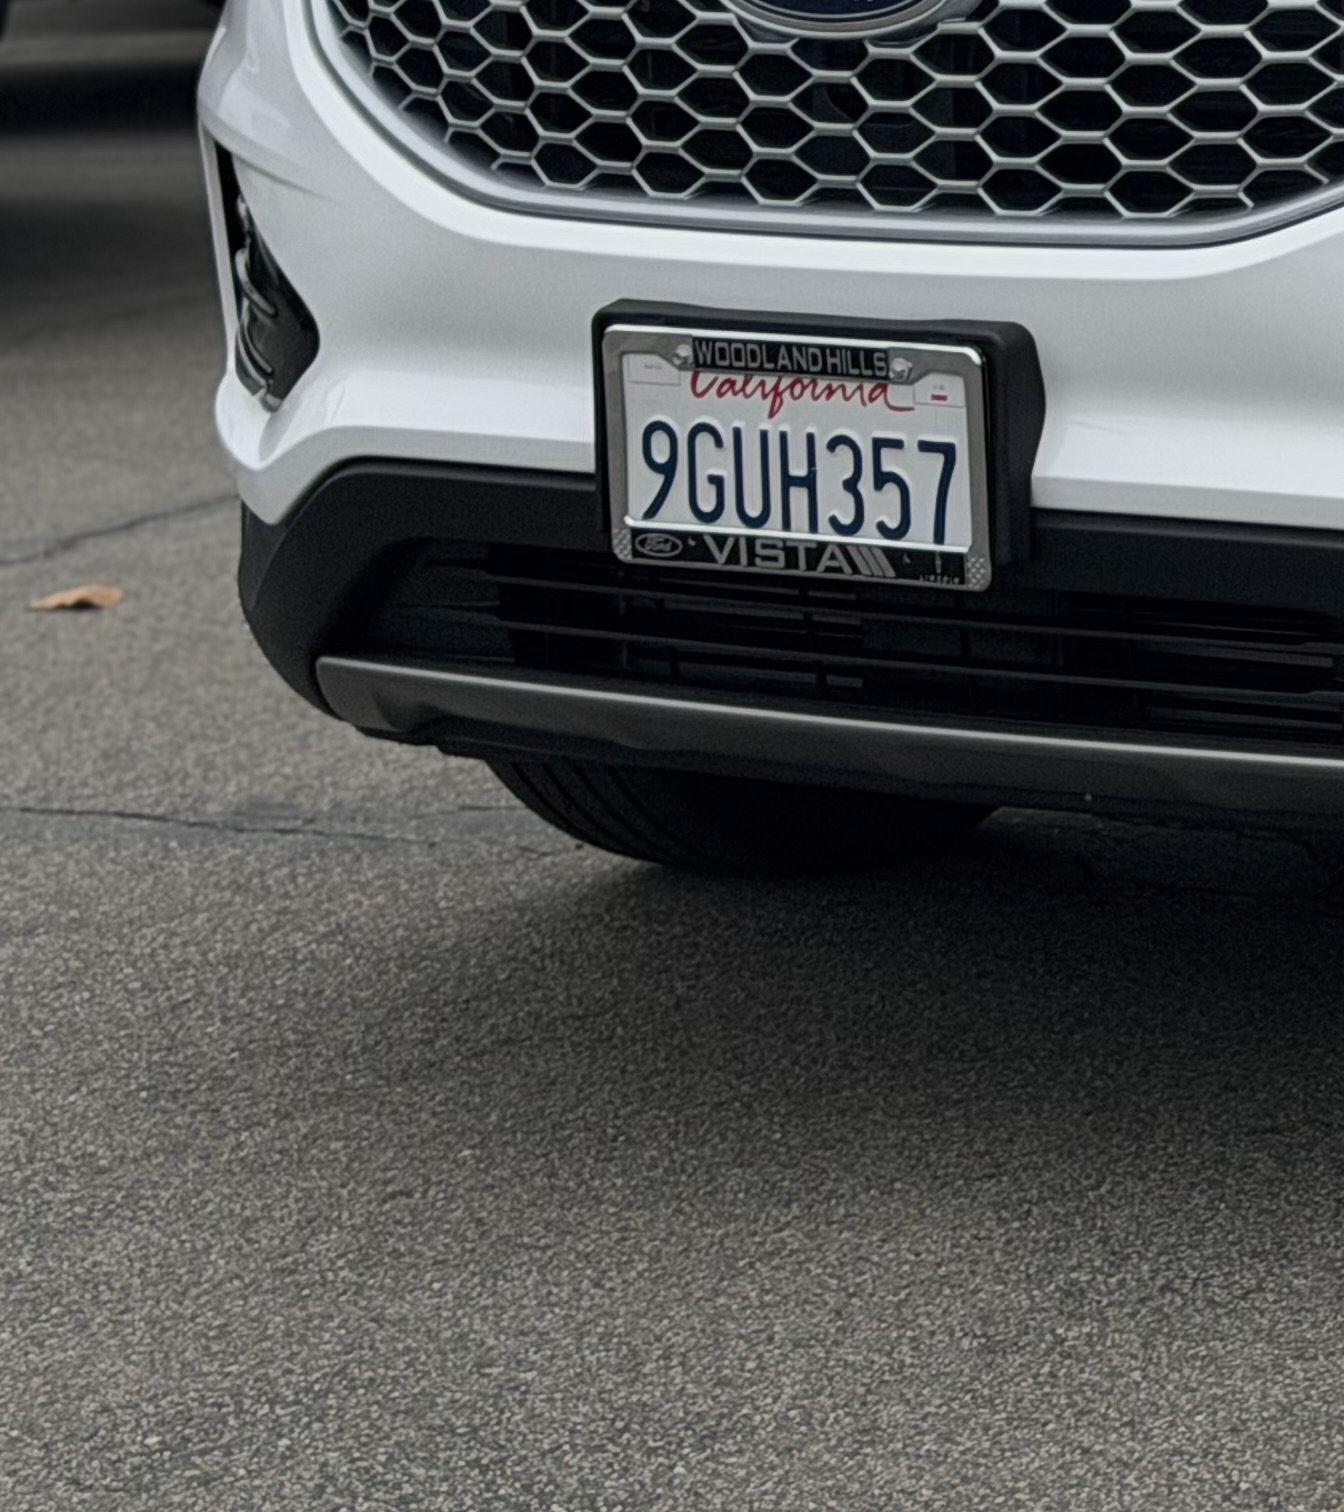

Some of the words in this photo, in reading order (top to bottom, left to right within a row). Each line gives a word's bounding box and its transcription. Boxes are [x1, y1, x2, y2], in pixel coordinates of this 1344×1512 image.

[695, 340, 824, 374] WOODLAND
[826, 348, 889, 377] HILLS
[691, 370, 915, 420] California
[641, 419, 957, 546] 9GUH357
[702, 533, 852, 576] VISTA
